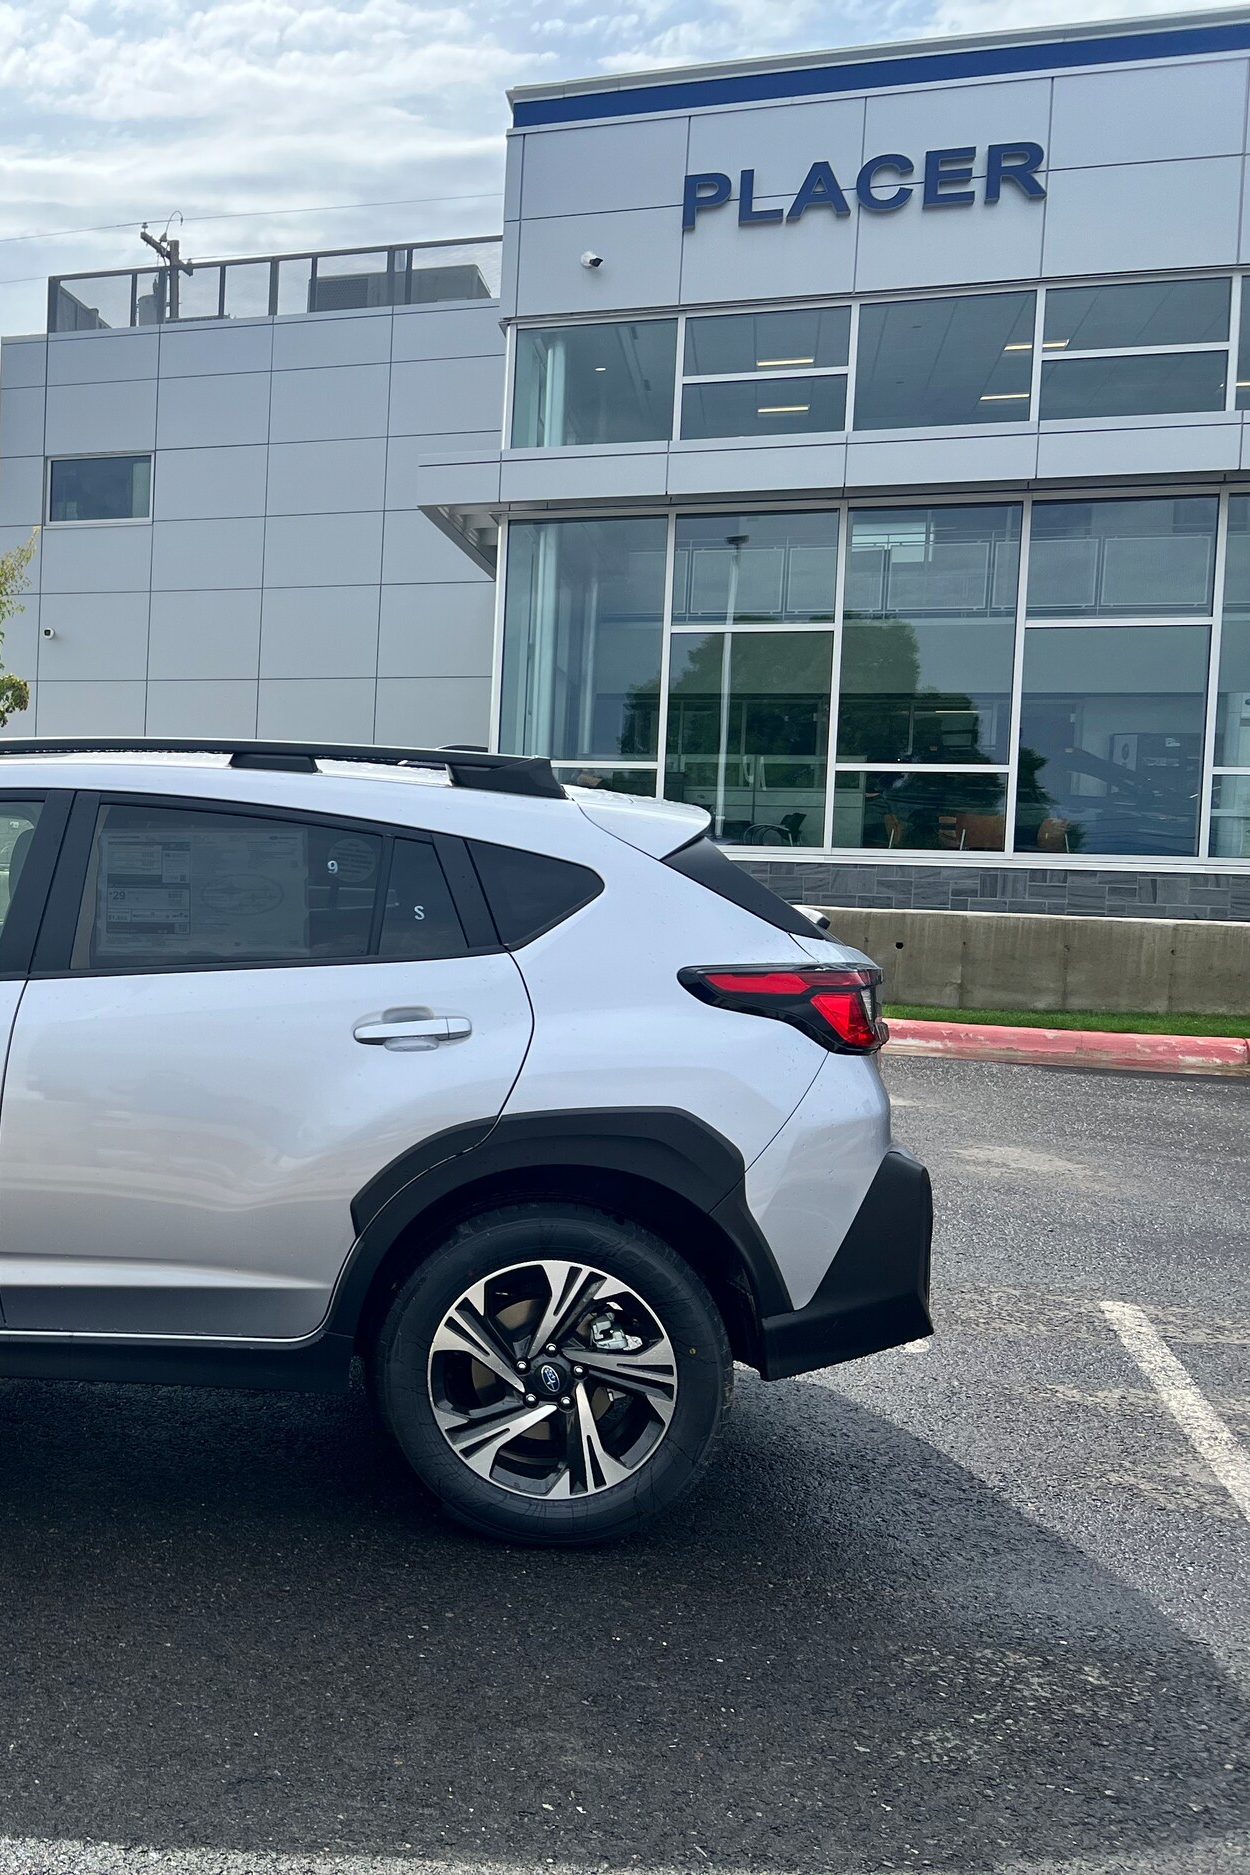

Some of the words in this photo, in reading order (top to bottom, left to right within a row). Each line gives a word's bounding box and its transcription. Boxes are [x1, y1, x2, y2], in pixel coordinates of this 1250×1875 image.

[682, 142, 1047, 231] PLACER
[327, 860, 338, 874] 9
[413, 905, 425, 920] S
